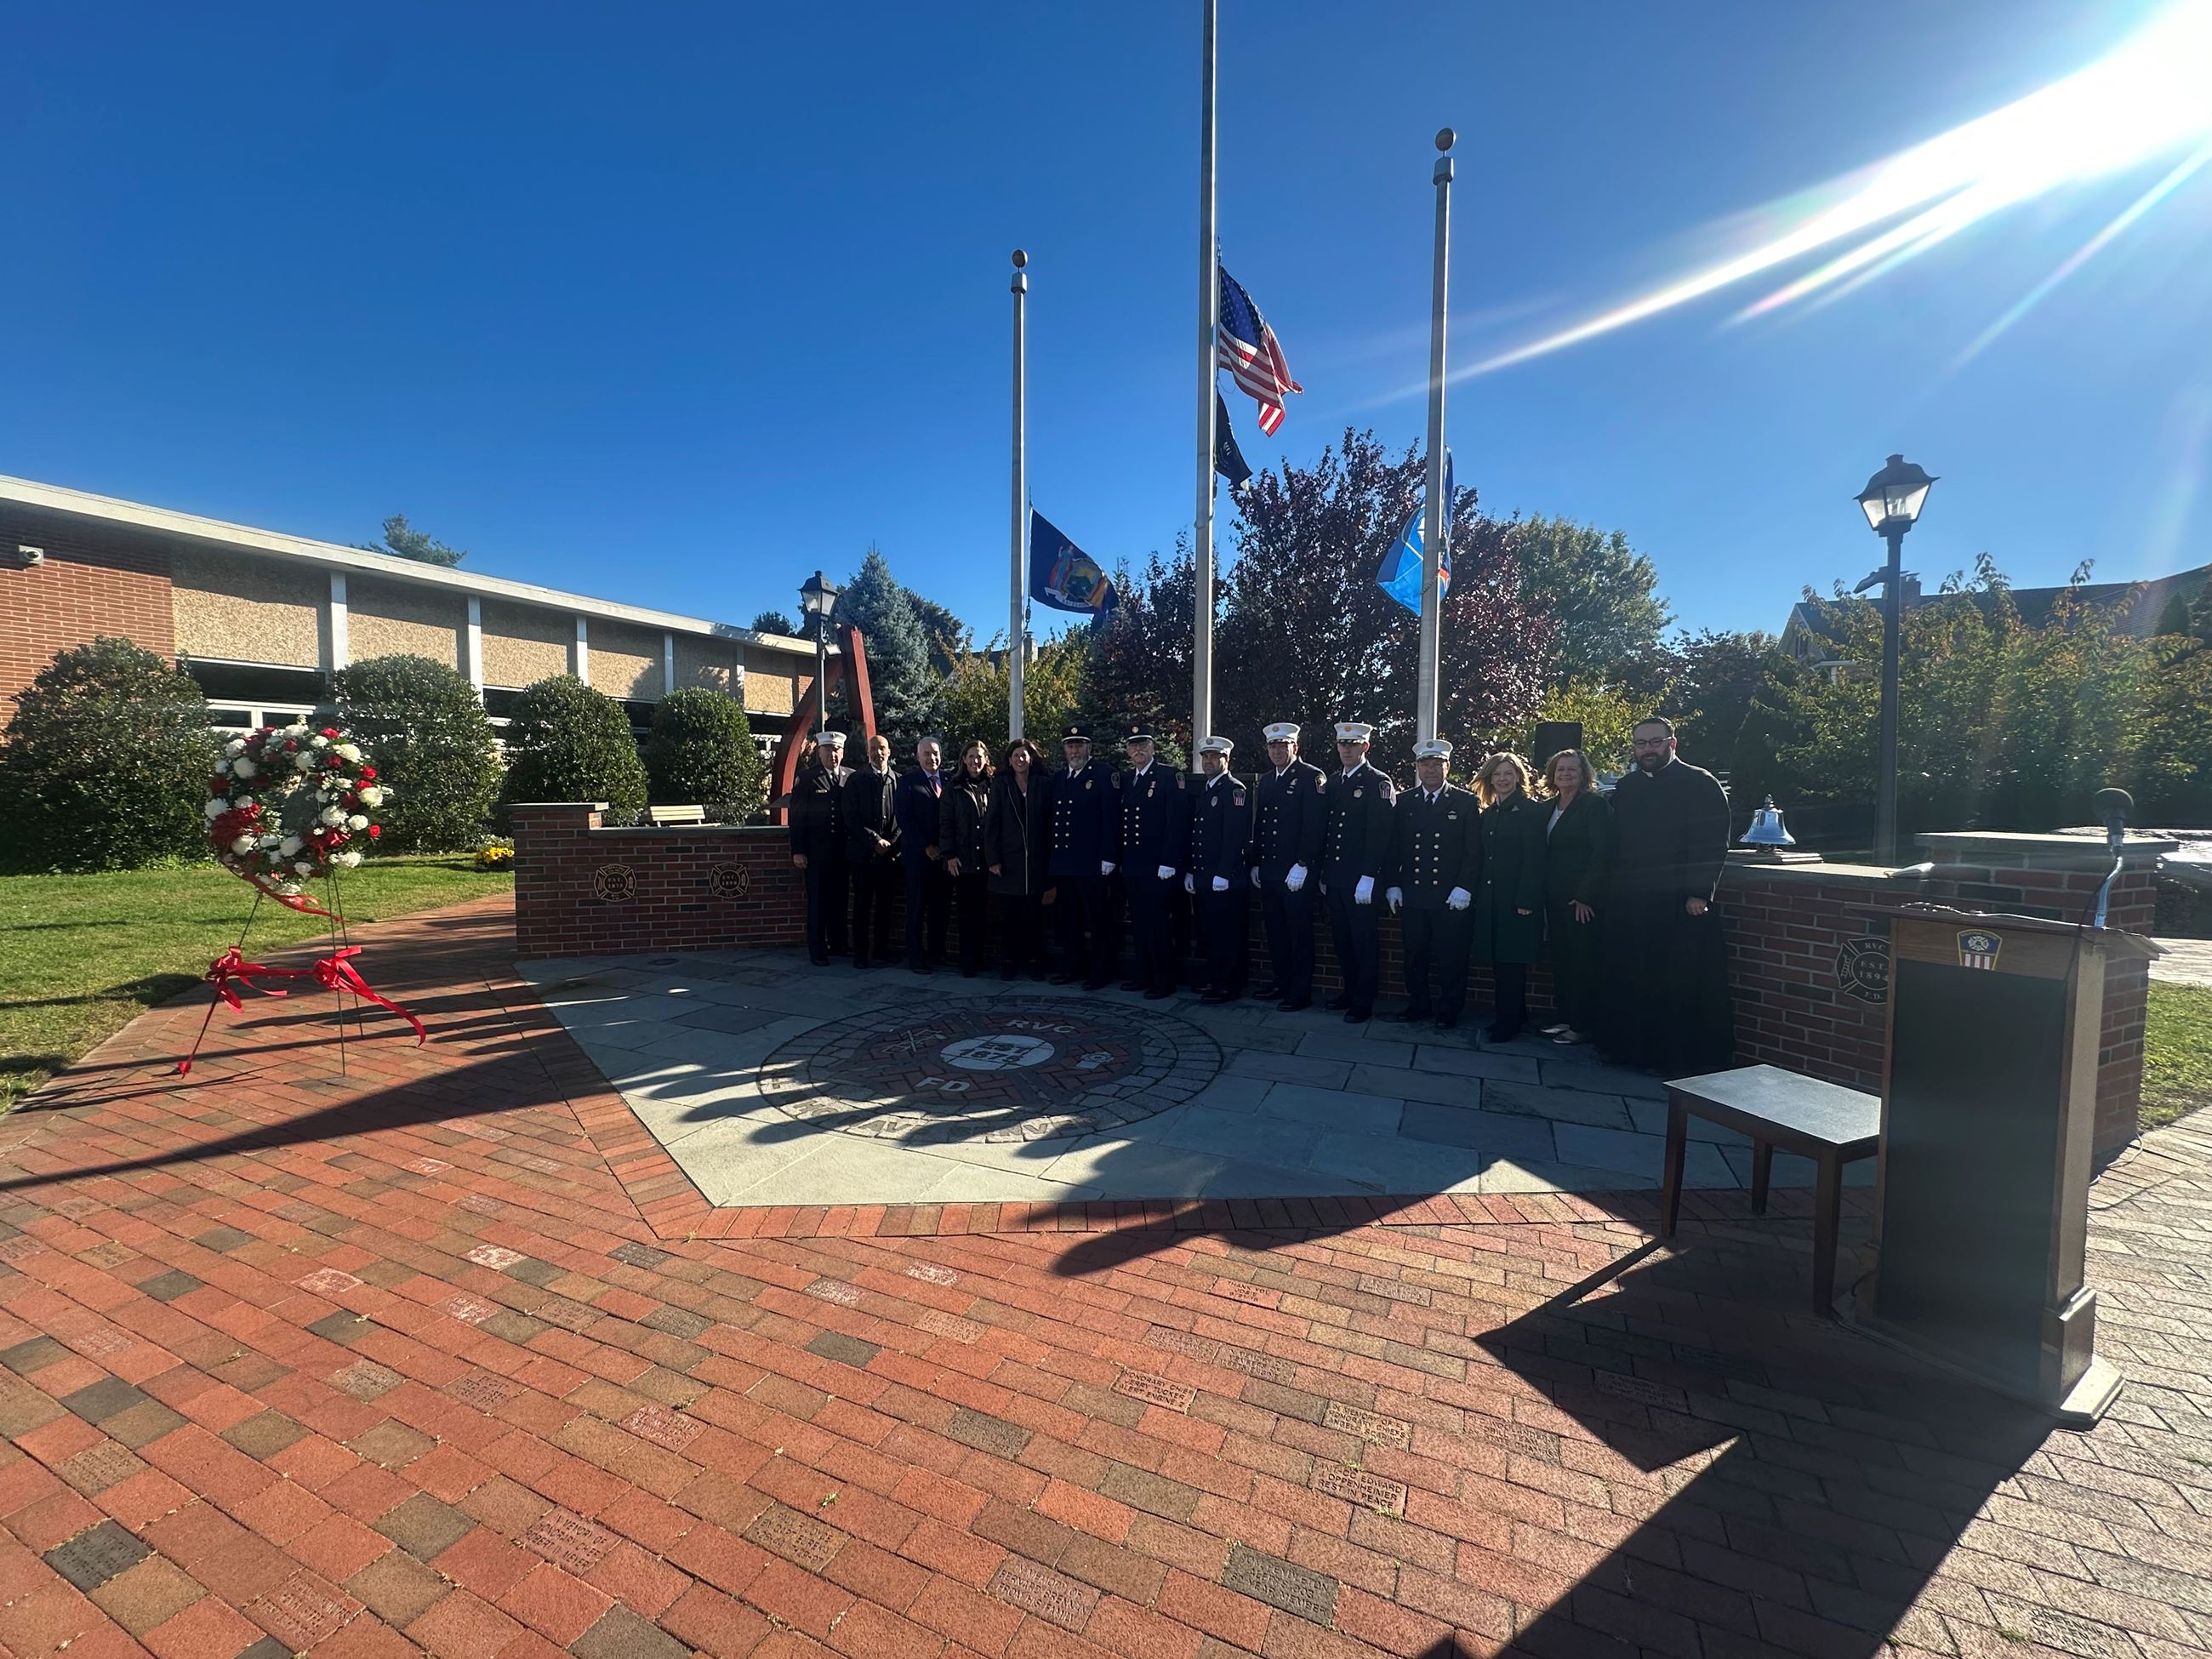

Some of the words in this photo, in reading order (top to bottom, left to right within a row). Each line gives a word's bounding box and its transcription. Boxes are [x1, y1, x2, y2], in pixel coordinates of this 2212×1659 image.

[1864, 942, 1886, 951] RVC
[1005, 1018, 1077, 1034] RVC
[913, 1076, 971, 1092] FD
[1228, 1280, 1252, 1291] THANK
[1119, 1383, 1145, 1394] ALERT
[1146, 1391, 1177, 1405] ENGINE
[1124, 1371, 1166, 1387] HONORARY
[1169, 1384, 1194, 1395] CHIEF
[1124, 1378, 1148, 1389] JERRY
[1154, 1386, 1185, 1400] TUCKER
[1344, 1407, 1379, 1422] MEMORY
[1318, 1479, 1343, 1492] REST
[1348, 1488, 1358, 1497] IN
[1360, 1492, 1394, 1508] PEACE
[1328, 1473, 1398, 1502] OPPENHEIMER
[1360, 1474, 1403, 1494] EDWARD
[562, 1519, 594, 1537] MEMORY
[592, 1536, 607, 1545] OF
[525, 1529, 556, 1548] ROBERT
[562, 1550, 591, 1570] MEYER
[996, 1582, 1023, 1599] FROM
[1024, 1594, 1042, 1608] HIS
[1246, 1579, 1276, 1596] YEAR
[1280, 1592, 1325, 1614] MEMBER
